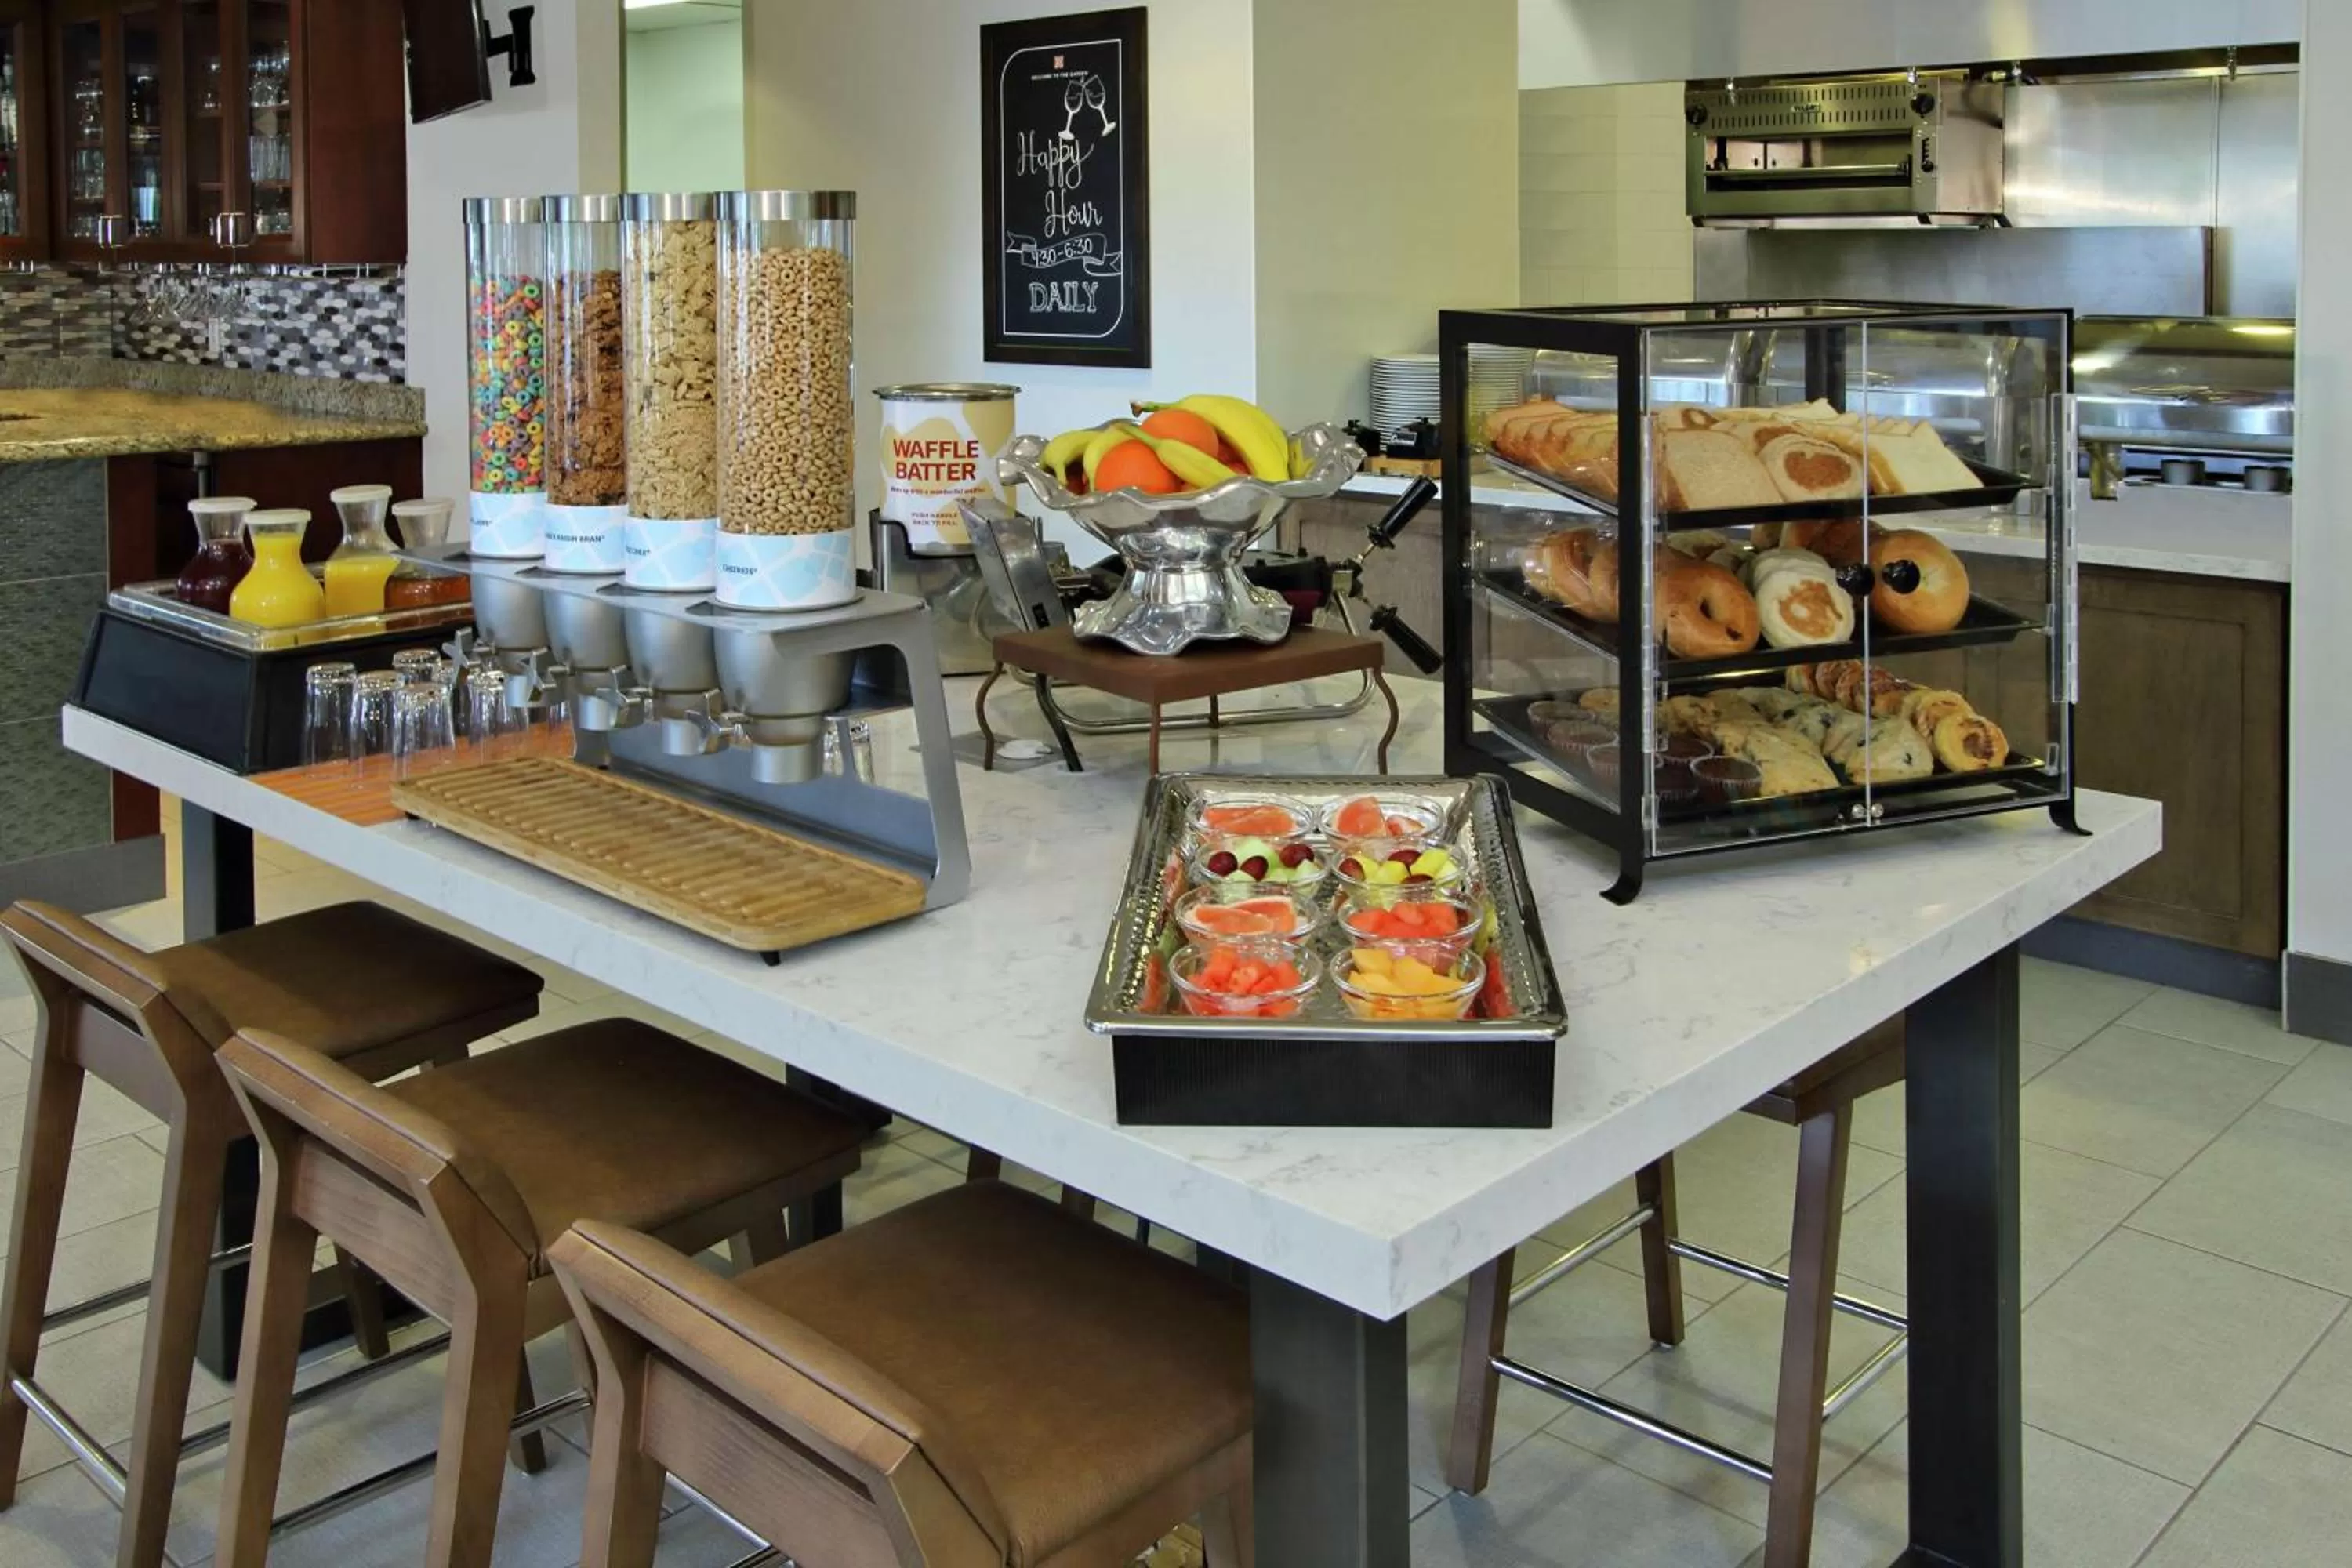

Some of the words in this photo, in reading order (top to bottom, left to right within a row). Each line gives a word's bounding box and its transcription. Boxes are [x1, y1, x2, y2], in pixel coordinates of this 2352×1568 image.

[1017, 129, 1094, 189] Happy
[1044, 189, 1102, 238] Hour
[1029, 281, 1099, 313] DAILY
[893, 439, 979, 459] WAFFLE
[895, 462, 977, 481] BATTER
